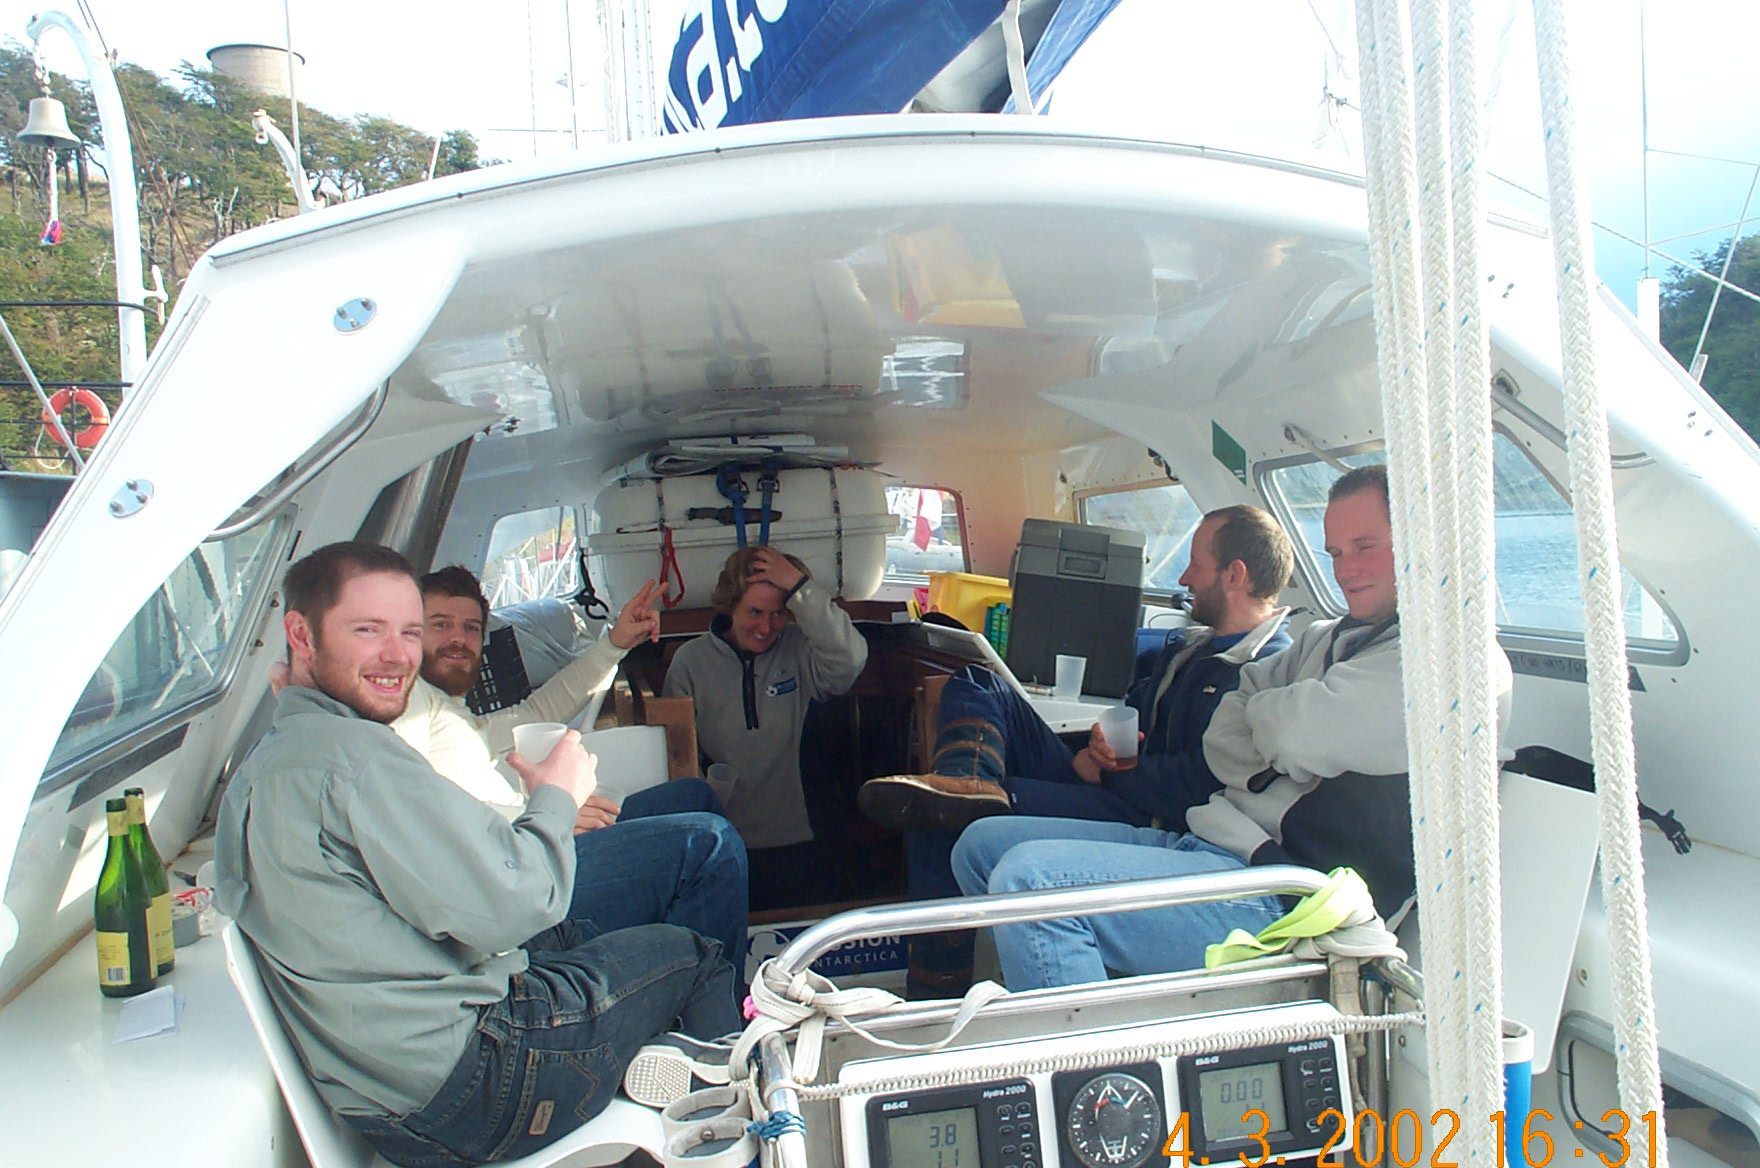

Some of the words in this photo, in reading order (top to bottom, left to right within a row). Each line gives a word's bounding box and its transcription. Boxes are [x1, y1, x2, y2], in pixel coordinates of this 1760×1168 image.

[813, 950, 898, 968] NTARCTICA
[1308, 1040, 1329, 1051] 2000
[1005, 1084, 1027, 1096] 2000
[882, 1101, 909, 1111] B&G
